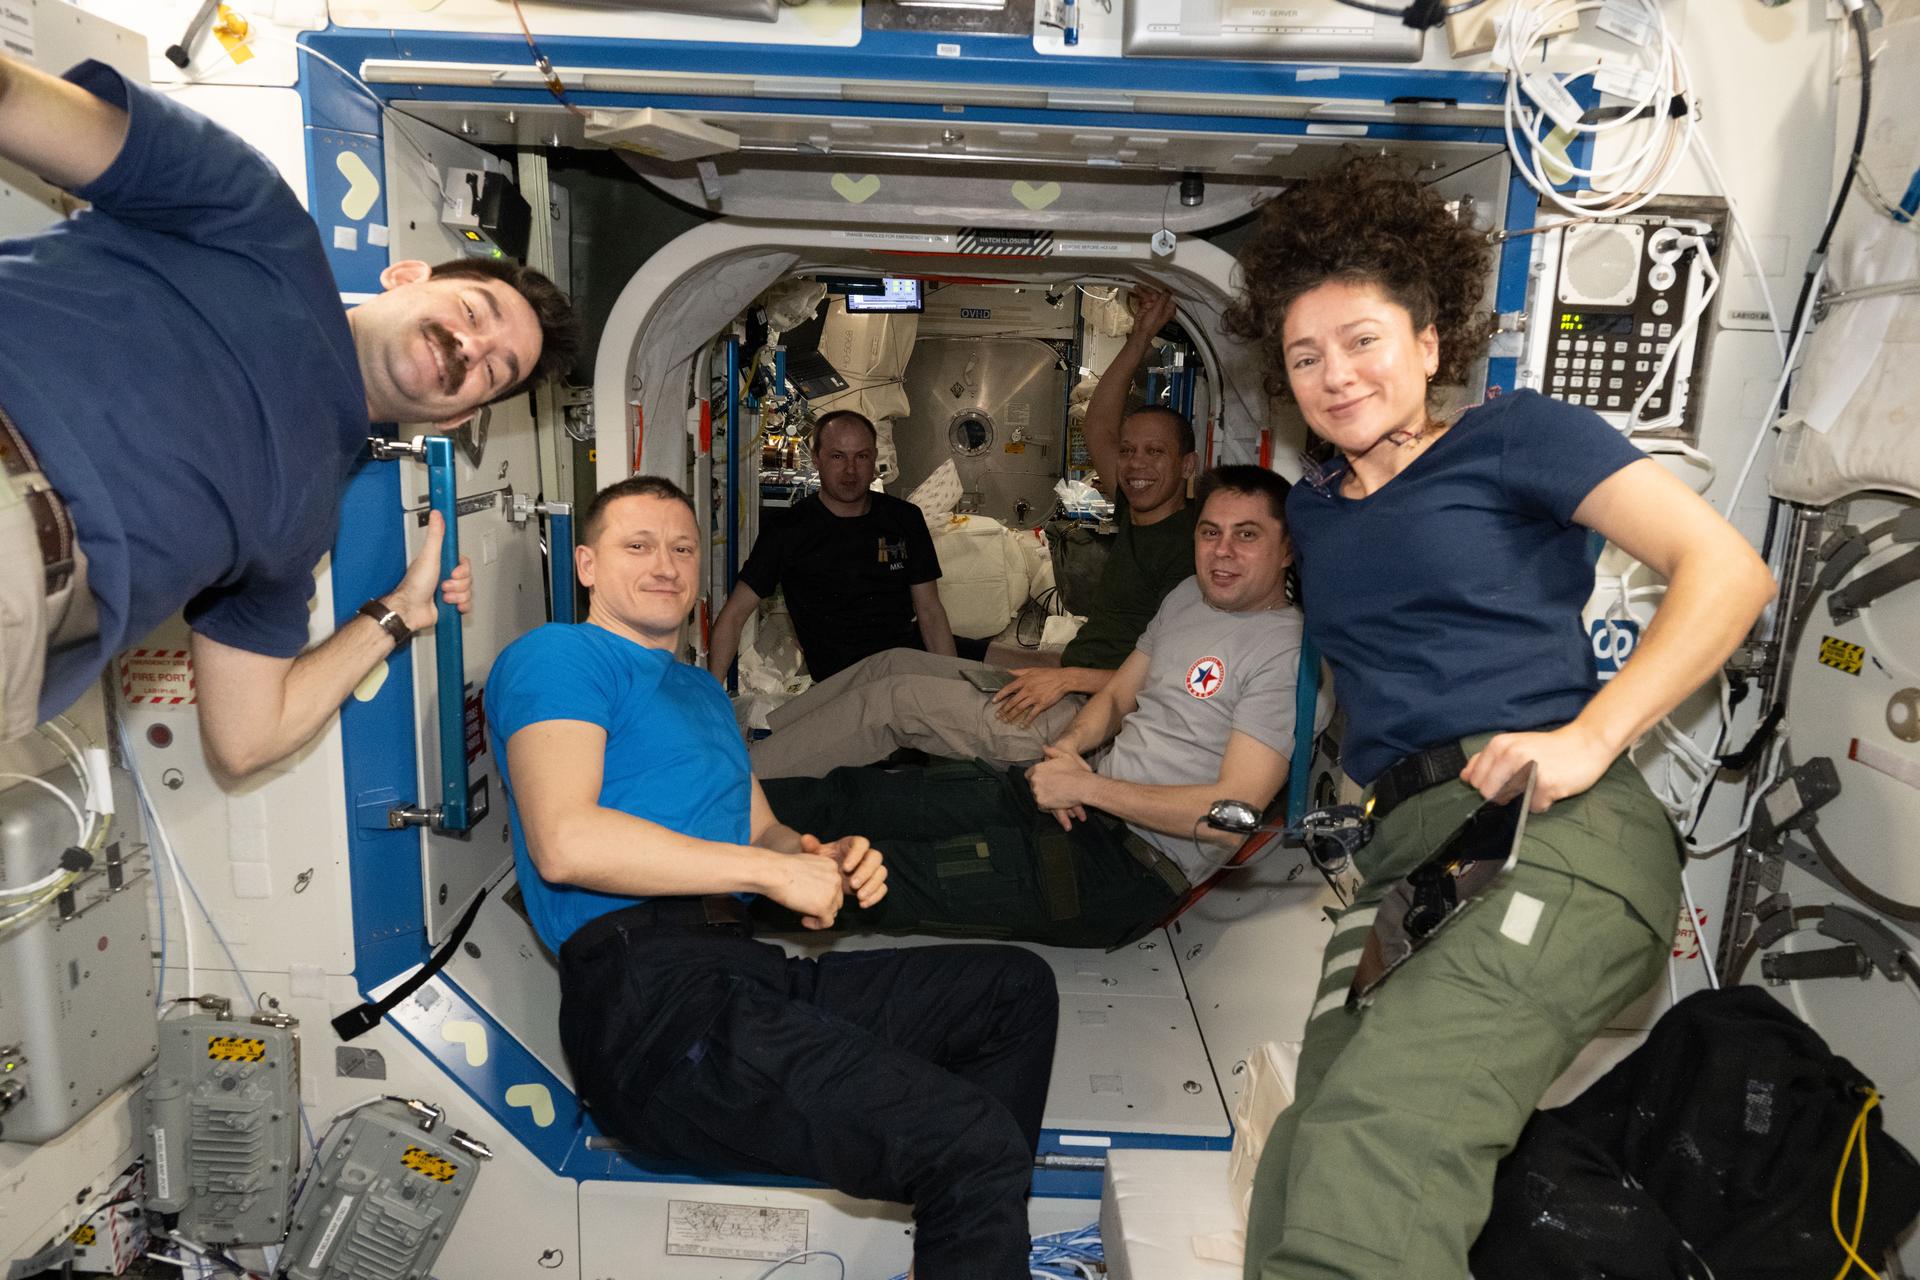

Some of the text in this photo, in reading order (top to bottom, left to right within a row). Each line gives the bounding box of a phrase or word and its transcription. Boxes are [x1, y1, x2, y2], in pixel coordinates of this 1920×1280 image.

[961, 309, 990, 319] OVHD
[132, 673, 186, 682] FIRE PORT
